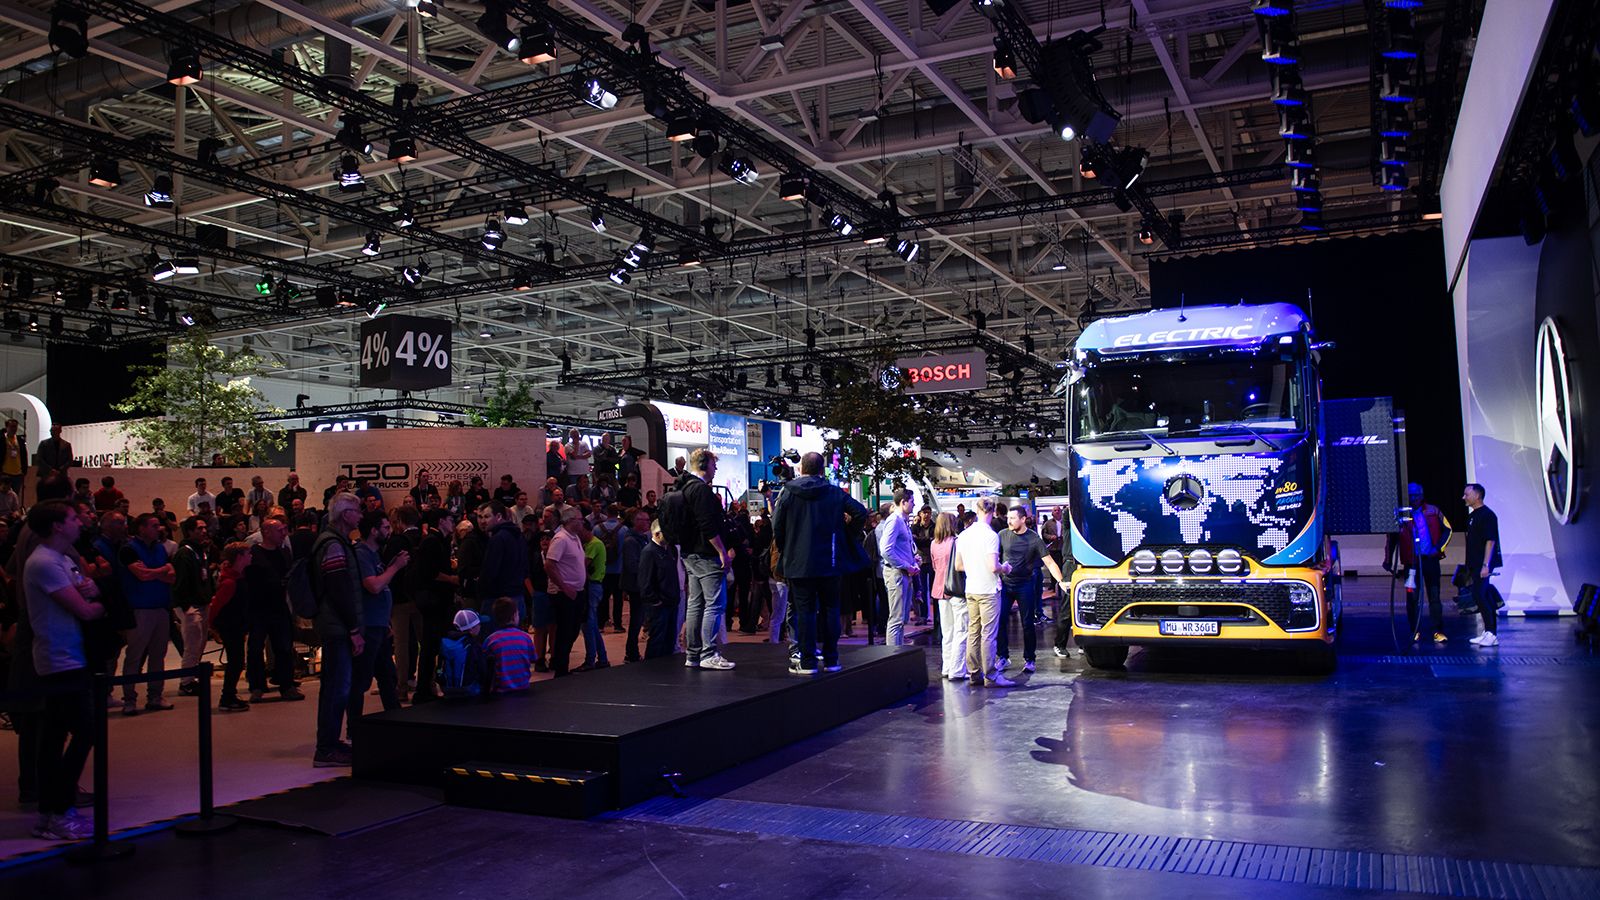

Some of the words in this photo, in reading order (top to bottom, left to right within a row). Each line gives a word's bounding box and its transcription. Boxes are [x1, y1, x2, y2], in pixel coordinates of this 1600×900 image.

[1114, 324, 1253, 347] ELECTRIC
[361, 330, 390, 371] 4%
[395, 329, 449, 371] 4%
[908, 363, 971, 383] BOSCH
[599, 408, 619, 421] ACTROS
[673, 417, 703, 433] BOSCH
[1340, 435, 1380, 446] DHL
[341, 463, 410, 480] 130
[1283, 481, 1297, 492] 80
[1182, 622, 1193, 632] WR
